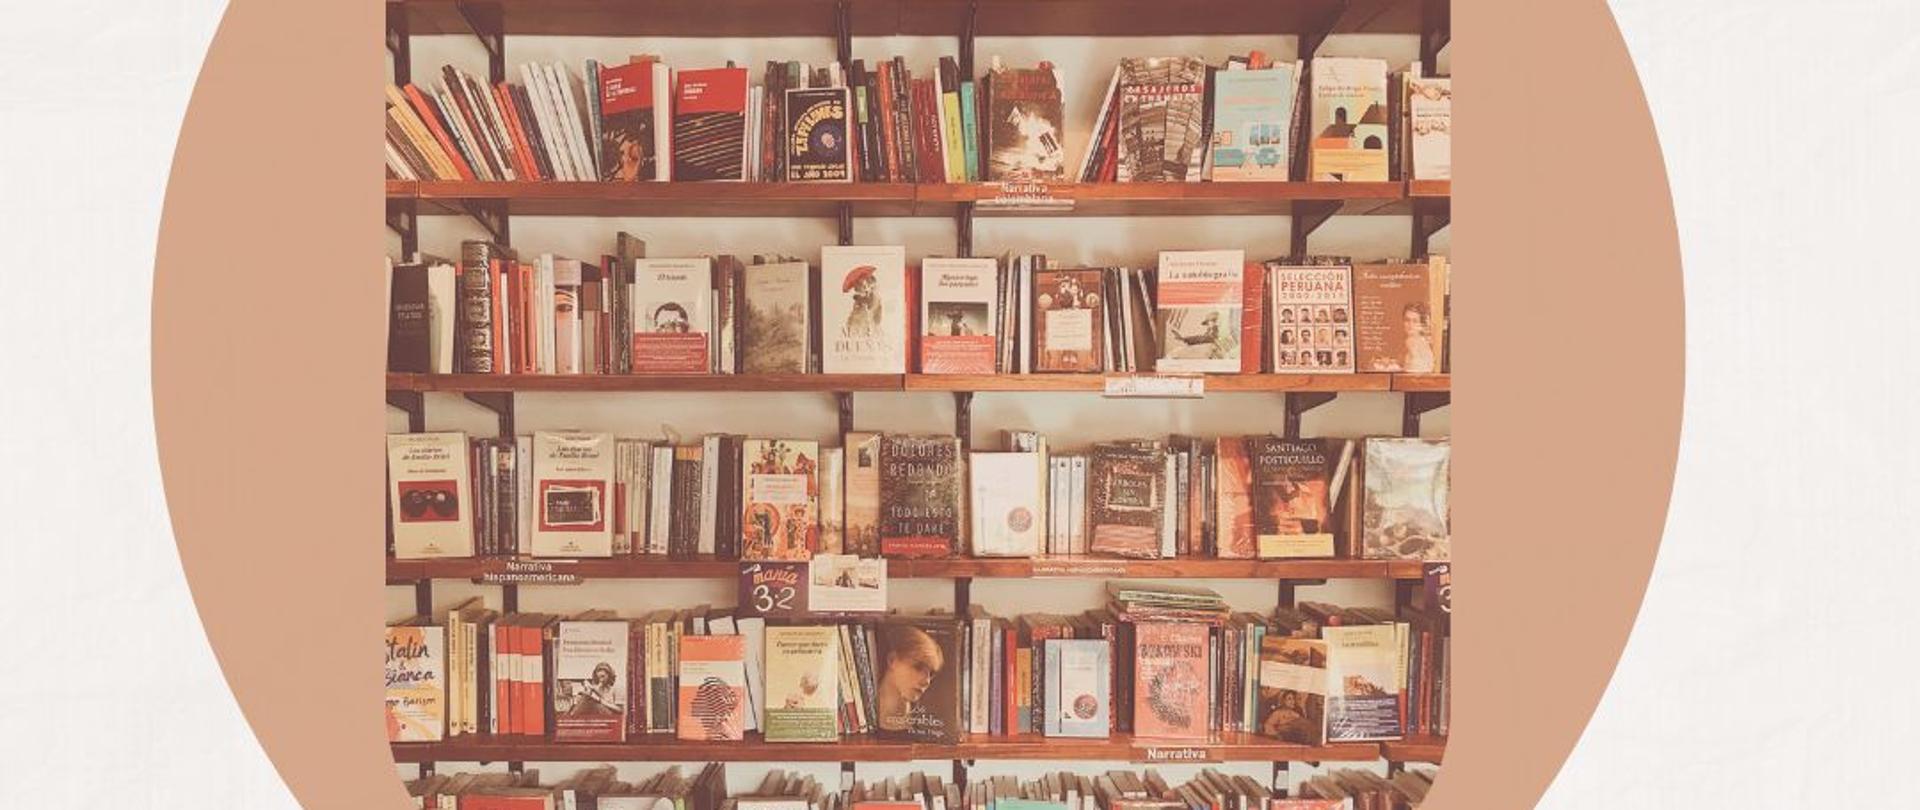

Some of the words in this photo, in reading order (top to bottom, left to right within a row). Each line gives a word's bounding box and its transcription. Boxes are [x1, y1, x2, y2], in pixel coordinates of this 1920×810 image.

[1002, 183, 1048, 193] Narrativa
[1281, 271, 1344, 281] SELECCIÓN
[1281, 282, 1344, 291] PERUANA
[891, 444, 952, 457] DOLORES
[1265, 442, 1317, 454] SANTIAGO
[1259, 455, 1326, 465] POSTEGUILLO
[506, 561, 552, 572] Narrativa
[385, 635, 430, 665] talin
[1147, 747, 1206, 760] Narrativa
